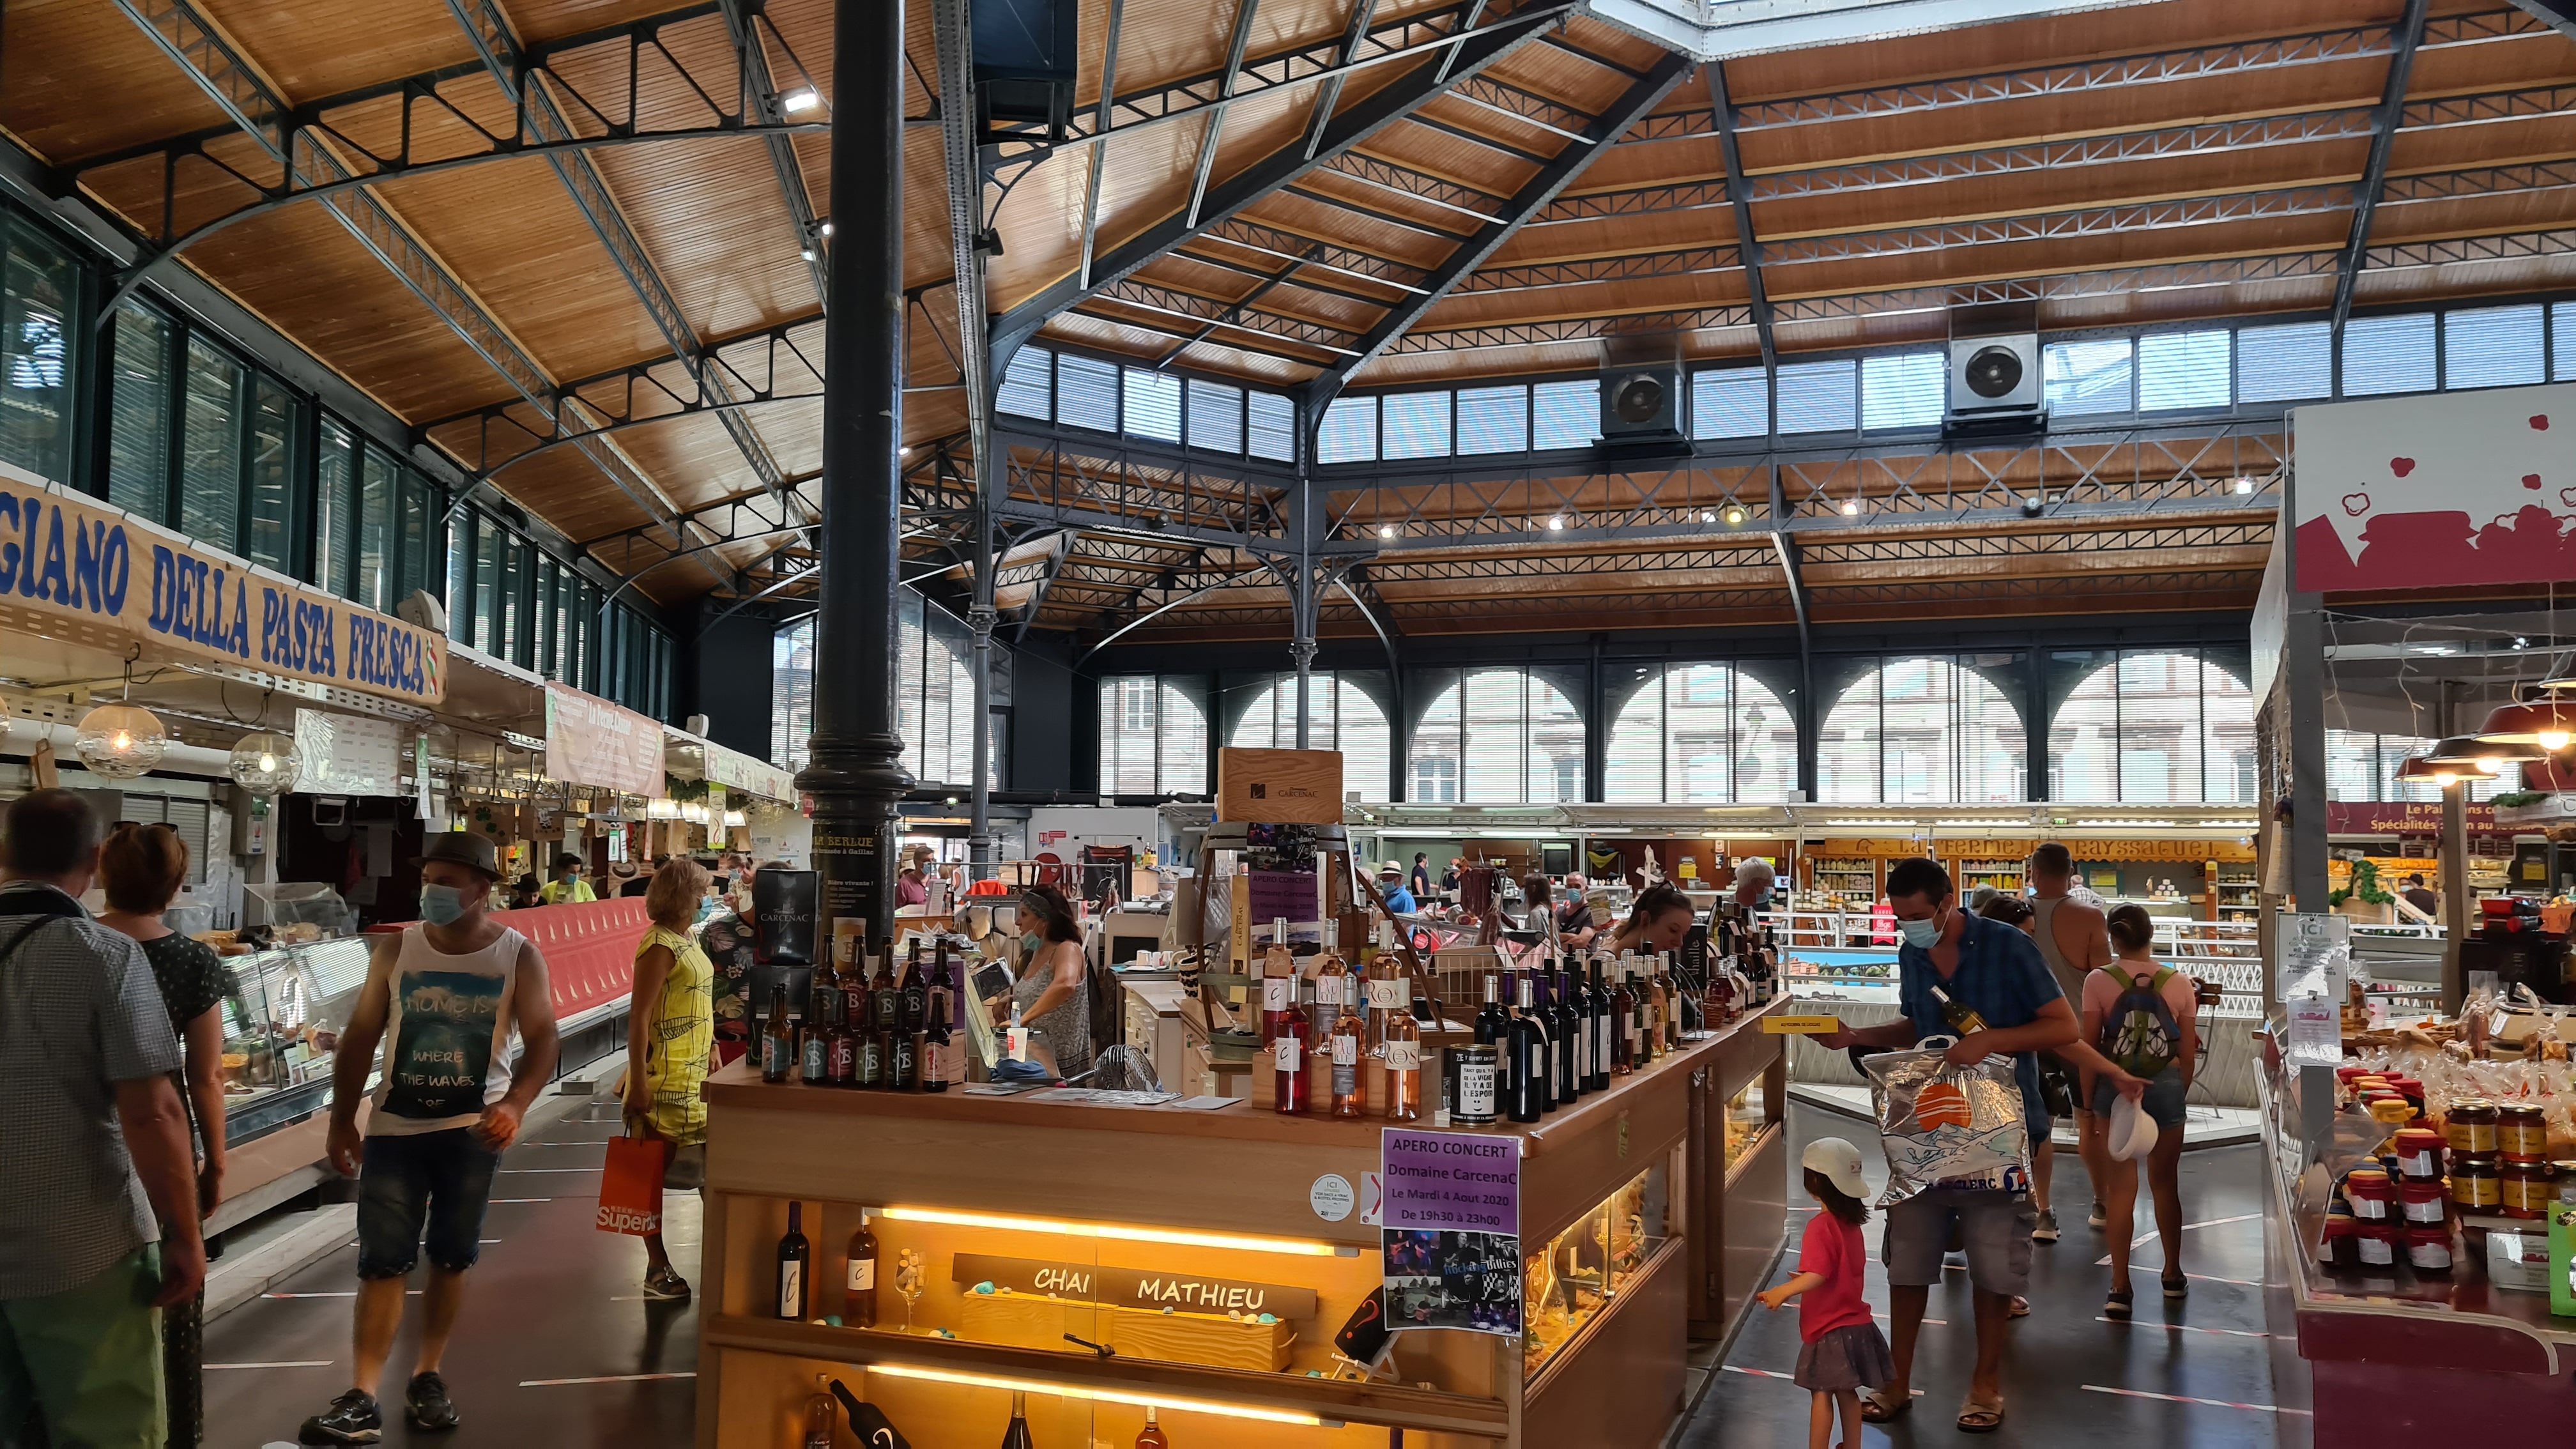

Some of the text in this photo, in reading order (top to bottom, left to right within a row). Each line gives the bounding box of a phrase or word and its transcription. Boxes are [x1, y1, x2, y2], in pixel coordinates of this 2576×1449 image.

[148, 544, 249, 659] DELLA
[261, 587, 336, 677] PASTA
[347, 613, 425, 696] FRESCA
[1278, 790, 1318, 798] CARCENAC
[2407, 804, 2420, 814] Le
[2371, 820, 2436, 831] Spécialités
[828, 836, 874, 847] BERLUE
[760, 913, 809, 923] CARCENAC
[407, 995, 490, 1013] HOME IS
[413, 1050, 464, 1063] WHERE
[400, 1072, 475, 1087] THE WAVES
[1393, 1138, 1508, 1158] APERO CONCERT
[1388, 1163, 1517, 1184] Domaine CarcenaC
[1392, 1188, 1509, 1206] Le Mardi 4 Aout 2020
[1401, 1209, 1500, 1226] De 19h30 à 23h00
[1034, 1268, 1264, 1310] CHAI MATHIEU
